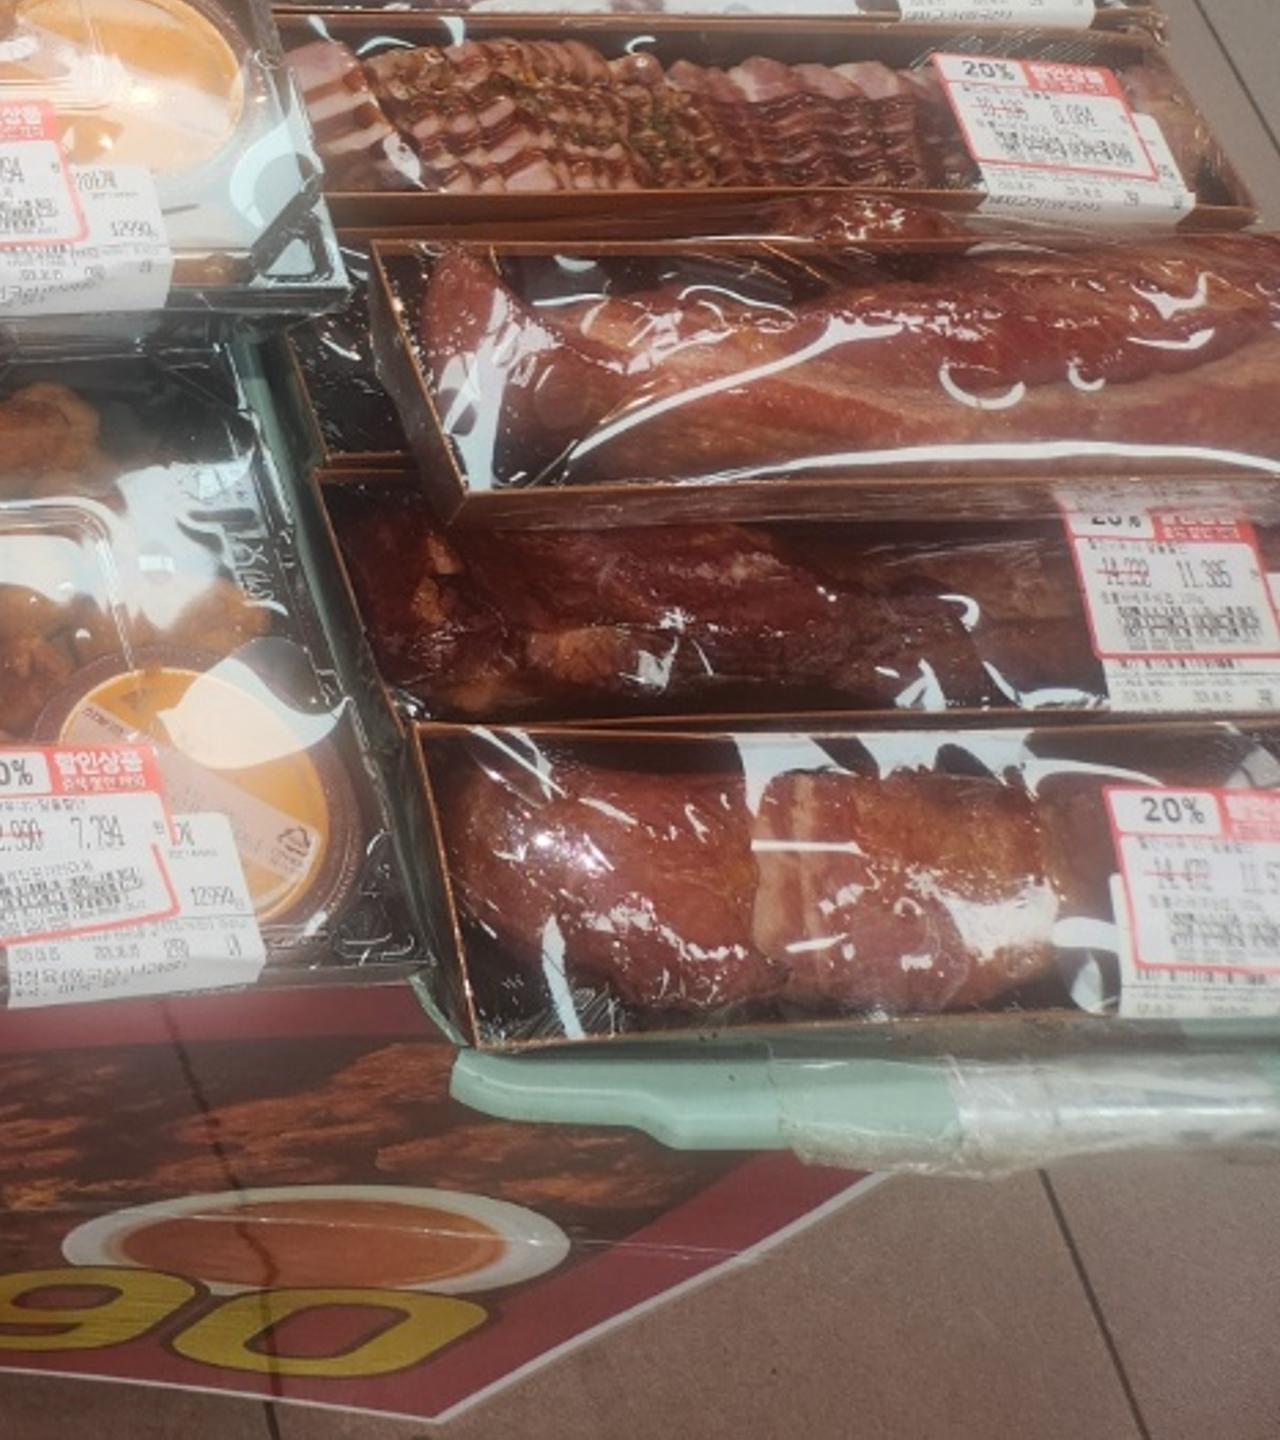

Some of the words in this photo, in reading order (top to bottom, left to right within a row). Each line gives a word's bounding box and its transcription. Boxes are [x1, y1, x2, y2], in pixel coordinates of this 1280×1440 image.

[962, 60, 1015, 81] 20%
[53, 750, 144, 776] 할인상품
[1140, 796, 1206, 824] 20%
